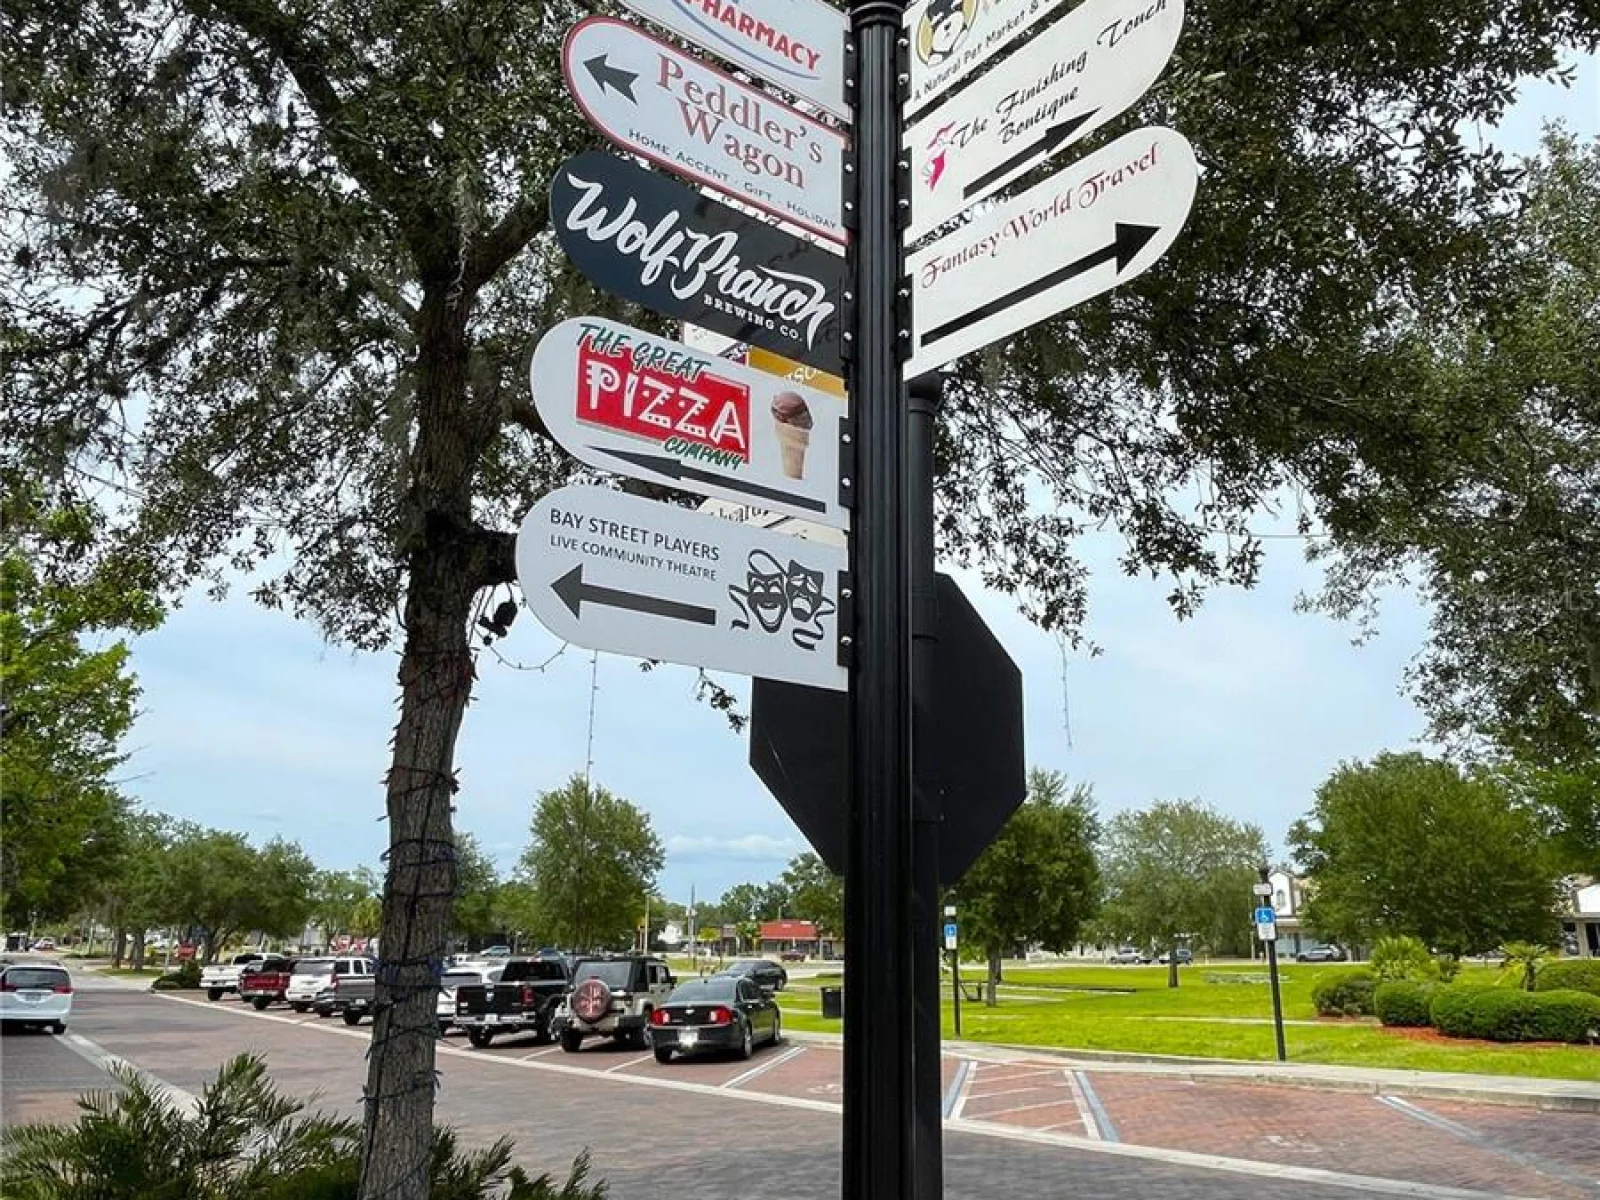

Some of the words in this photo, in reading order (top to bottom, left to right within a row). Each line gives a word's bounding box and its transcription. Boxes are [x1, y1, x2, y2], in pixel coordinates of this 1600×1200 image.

[684, 0, 821, 71] HARMACY
[924, 59, 961, 94] Natural
[986, 10, 1025, 46] Market
[656, 52, 822, 164] Peddler's
[950, 117, 988, 148] The
[995, 51, 1088, 125] Finishing
[998, 86, 1078, 144] Boutique
[676, 98, 805, 189] Wagon
[921, 232, 1001, 288] Fantasy
[1002, 189, 1074, 240] World
[1078, 142, 1159, 208] Travel
[703, 293, 775, 330] BREWING
[577, 323, 631, 357] THE
[632, 342, 711, 383] GREAT
[586, 360, 746, 449] PIZZA
[664, 437, 743, 470] COMPANY
[550, 508, 584, 529] BAY
[588, 517, 649, 545] STREET
[654, 533, 720, 561] PLAYERS
[550, 535, 578, 550] LIVE
[582, 541, 664, 569] COMMUNITY
[667, 559, 717, 581] THEATRE
